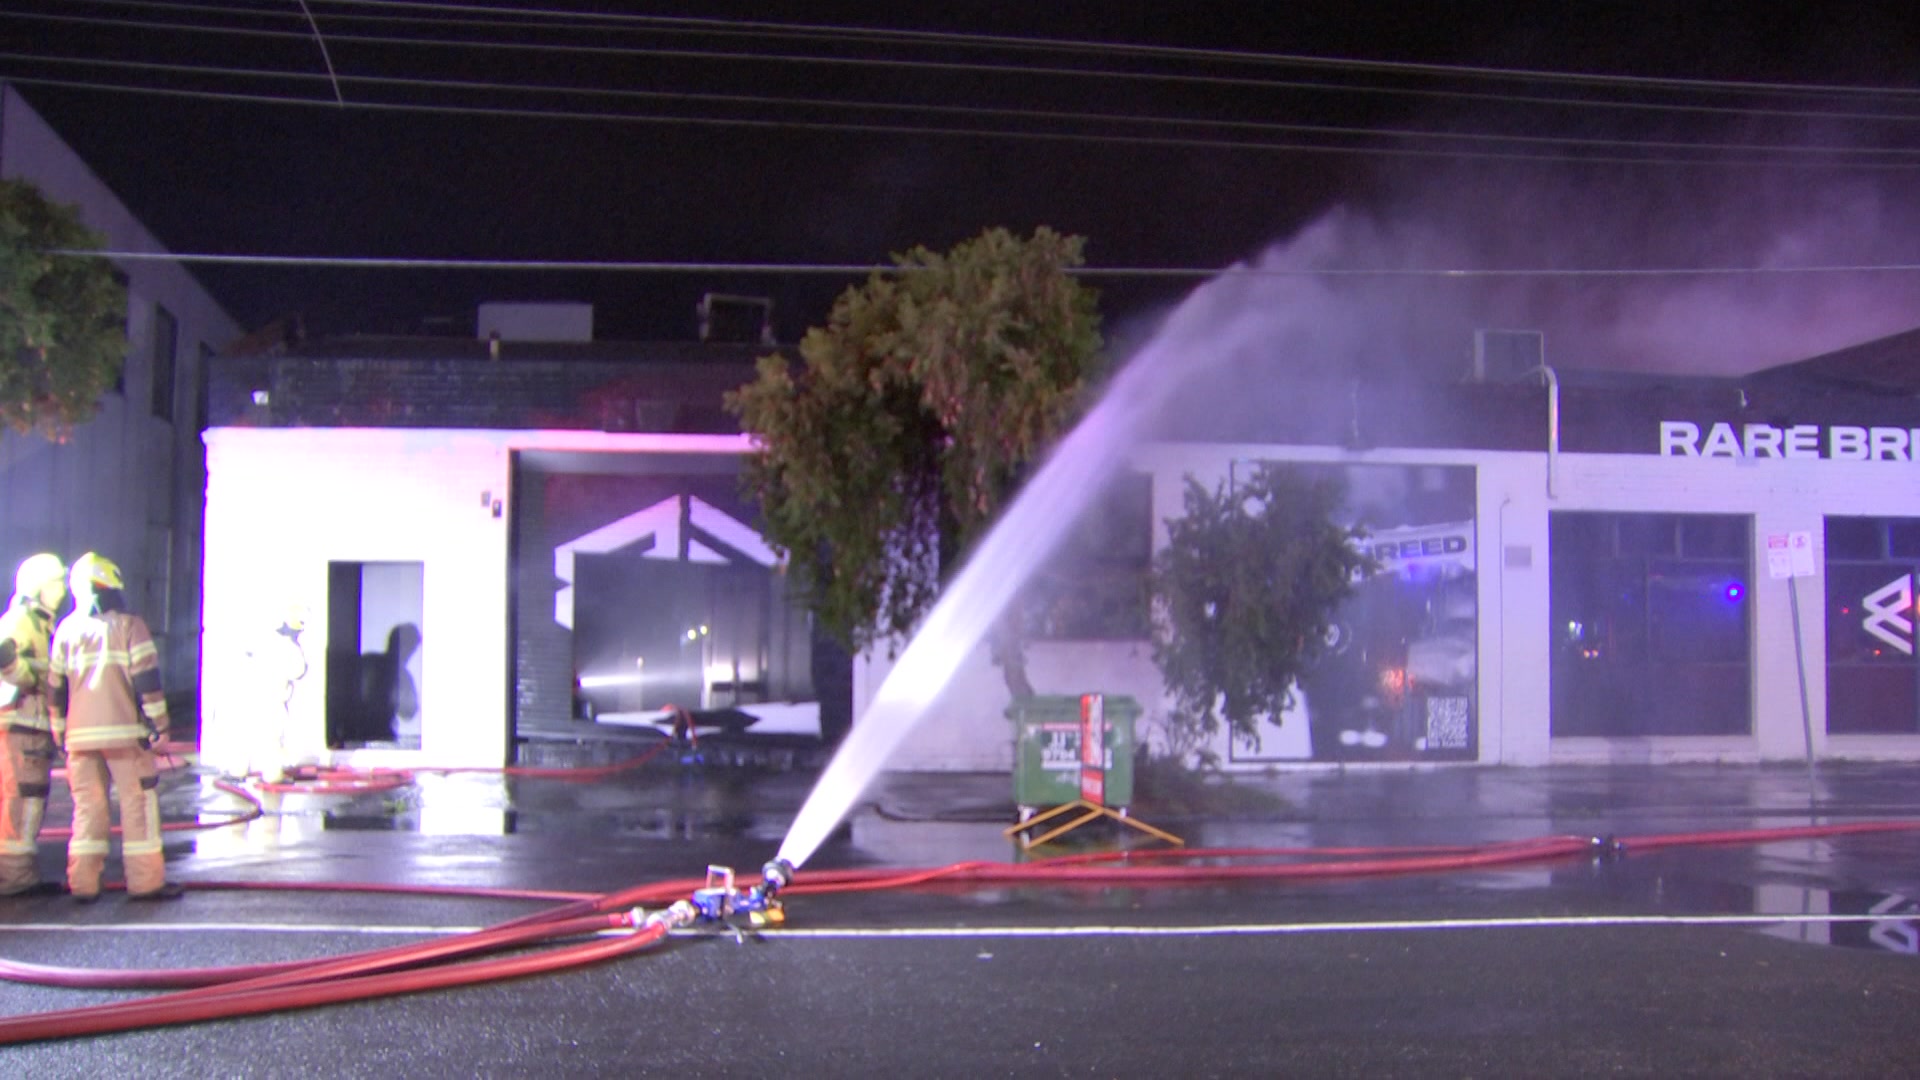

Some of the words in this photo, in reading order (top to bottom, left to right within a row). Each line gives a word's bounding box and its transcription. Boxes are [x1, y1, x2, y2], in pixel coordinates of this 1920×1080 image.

[1660, 421, 1820, 459] RARE
[1829, 426, 1920, 461] BR
[1372, 534, 1467, 560] REED
